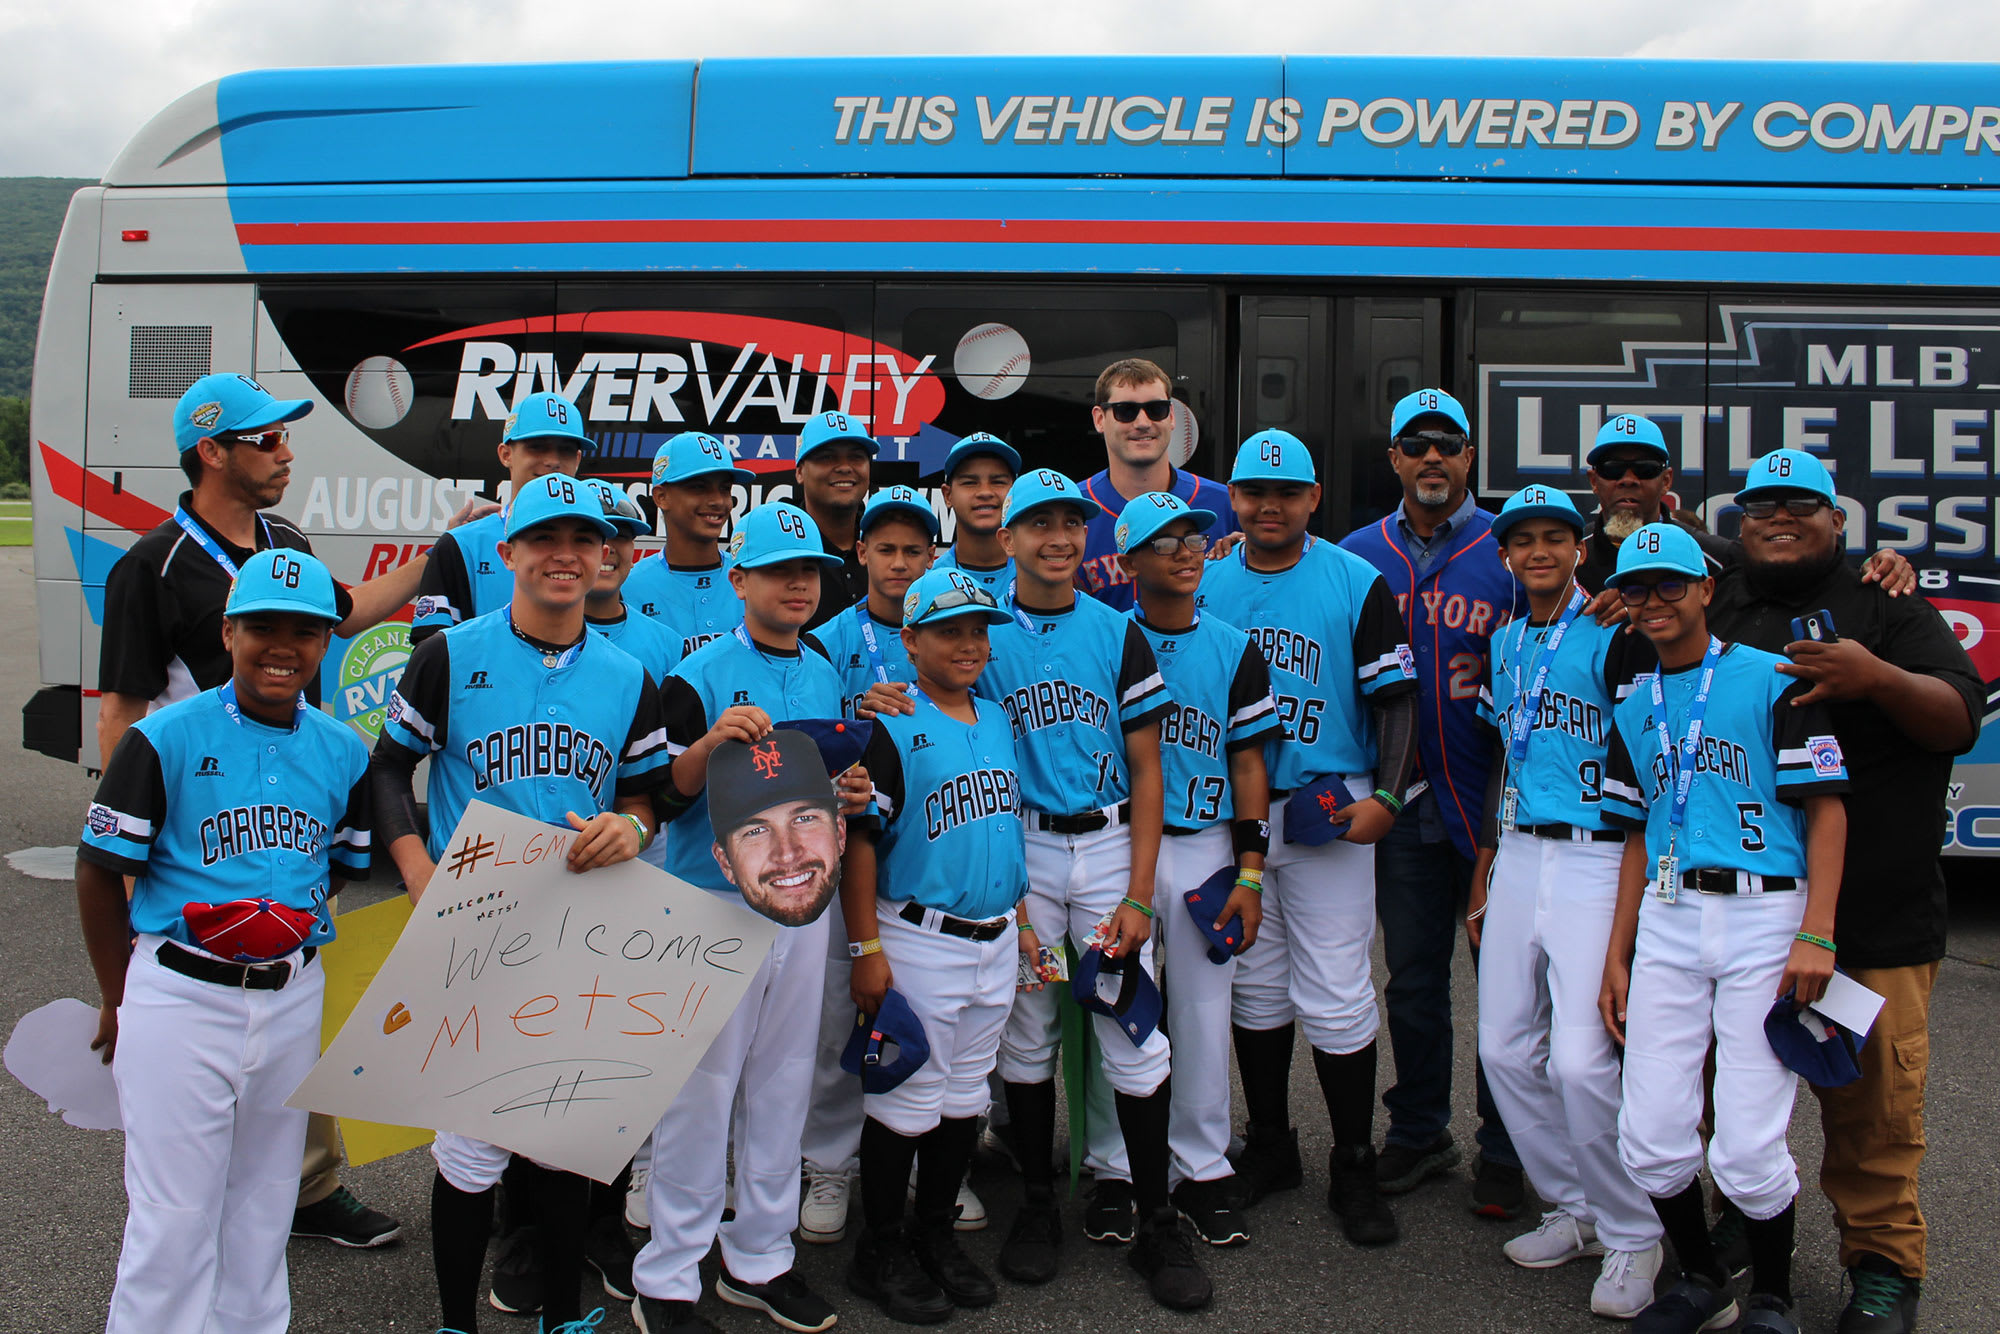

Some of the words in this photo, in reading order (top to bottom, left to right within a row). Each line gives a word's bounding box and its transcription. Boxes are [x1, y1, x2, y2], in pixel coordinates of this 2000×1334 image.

[834, 96, 958, 145] THIS
[975, 96, 1233, 146] VEHICLE
[1245, 98, 1302, 148] IS
[1317, 97, 1641, 150] POWERED
[1655, 101, 1744, 152] BY
[1806, 344, 1970, 388] MLB
[450, 341, 687, 422] RIVER
[689, 341, 937, 426] VALLEY
[545, 397, 568, 425] CB
[1418, 390, 1438, 411] CB
[824, 411, 848, 432] CB
[1614, 415, 1637, 435] CB
[697, 435, 722, 460] CB
[1260, 439, 1282, 467] CB
[1767, 452, 1792, 478] CB
[545, 476, 576, 505] CB
[1038, 469, 1065, 491] CB
[1147, 493, 1179, 511] CB
[776, 508, 807, 540] CB
[1636, 527, 1660, 554] CB
[270, 553, 301, 589] CB
[350, 631, 416, 678] CLEANE
[1276, 695, 1327, 747] 26
[194, 769, 226, 778] RUSSELL
[1577, 759, 1603, 804] 9
[1184, 774, 1226, 822] 13
[1736, 801, 1767, 853] 5
[437, 890, 504, 918] WELCOME
[477, 901, 519, 922] METS!
[444, 907, 745, 989] Welcome
[420, 975, 710, 1073] Mets!!
